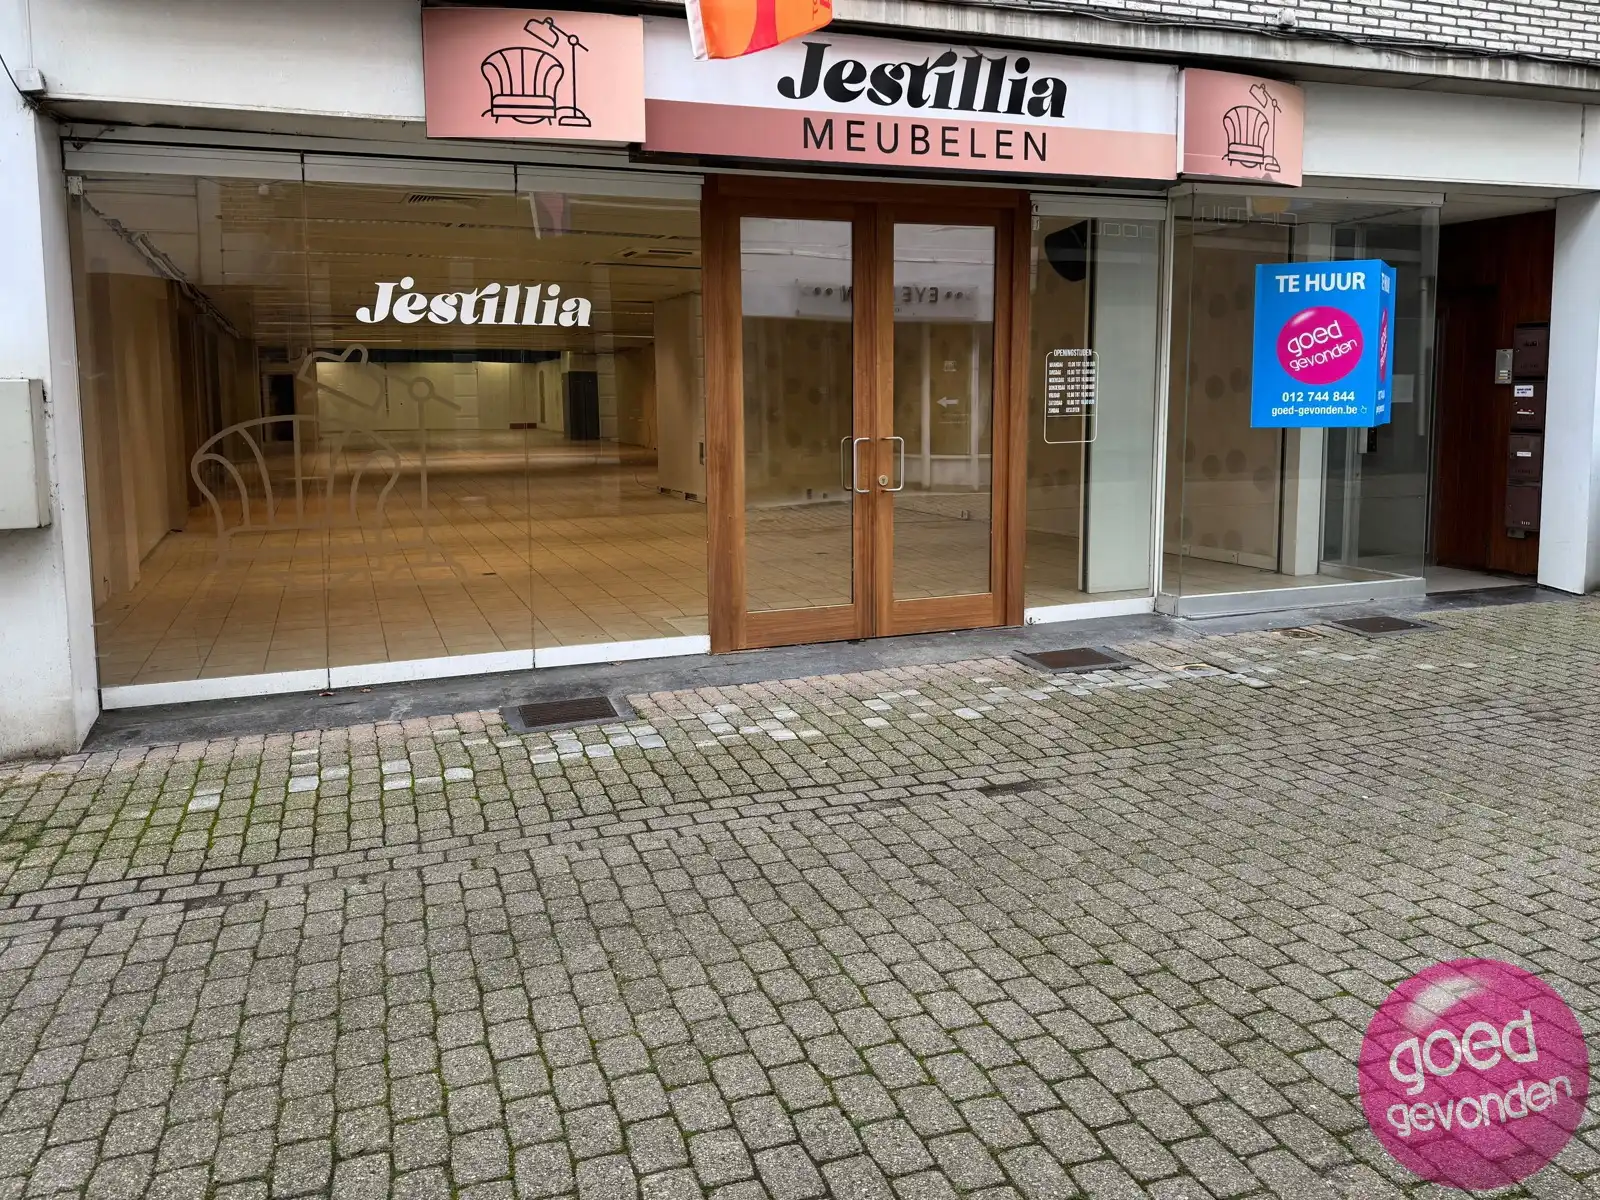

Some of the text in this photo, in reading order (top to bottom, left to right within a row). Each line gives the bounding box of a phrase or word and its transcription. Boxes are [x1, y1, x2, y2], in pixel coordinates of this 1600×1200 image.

[777, 41, 1068, 118] Jestillia
[803, 117, 1047, 161] MEUBELEN
[1275, 274, 1300, 293] TE
[1305, 272, 1366, 292] HUUR
[355, 276, 592, 327] Jestillia
[1287, 320, 1343, 357] goed
[1289, 339, 1358, 371] gevonden
[1271, 405, 1358, 416] goed-gevonden.be
[1282, 391, 1355, 402] 012 744 844
